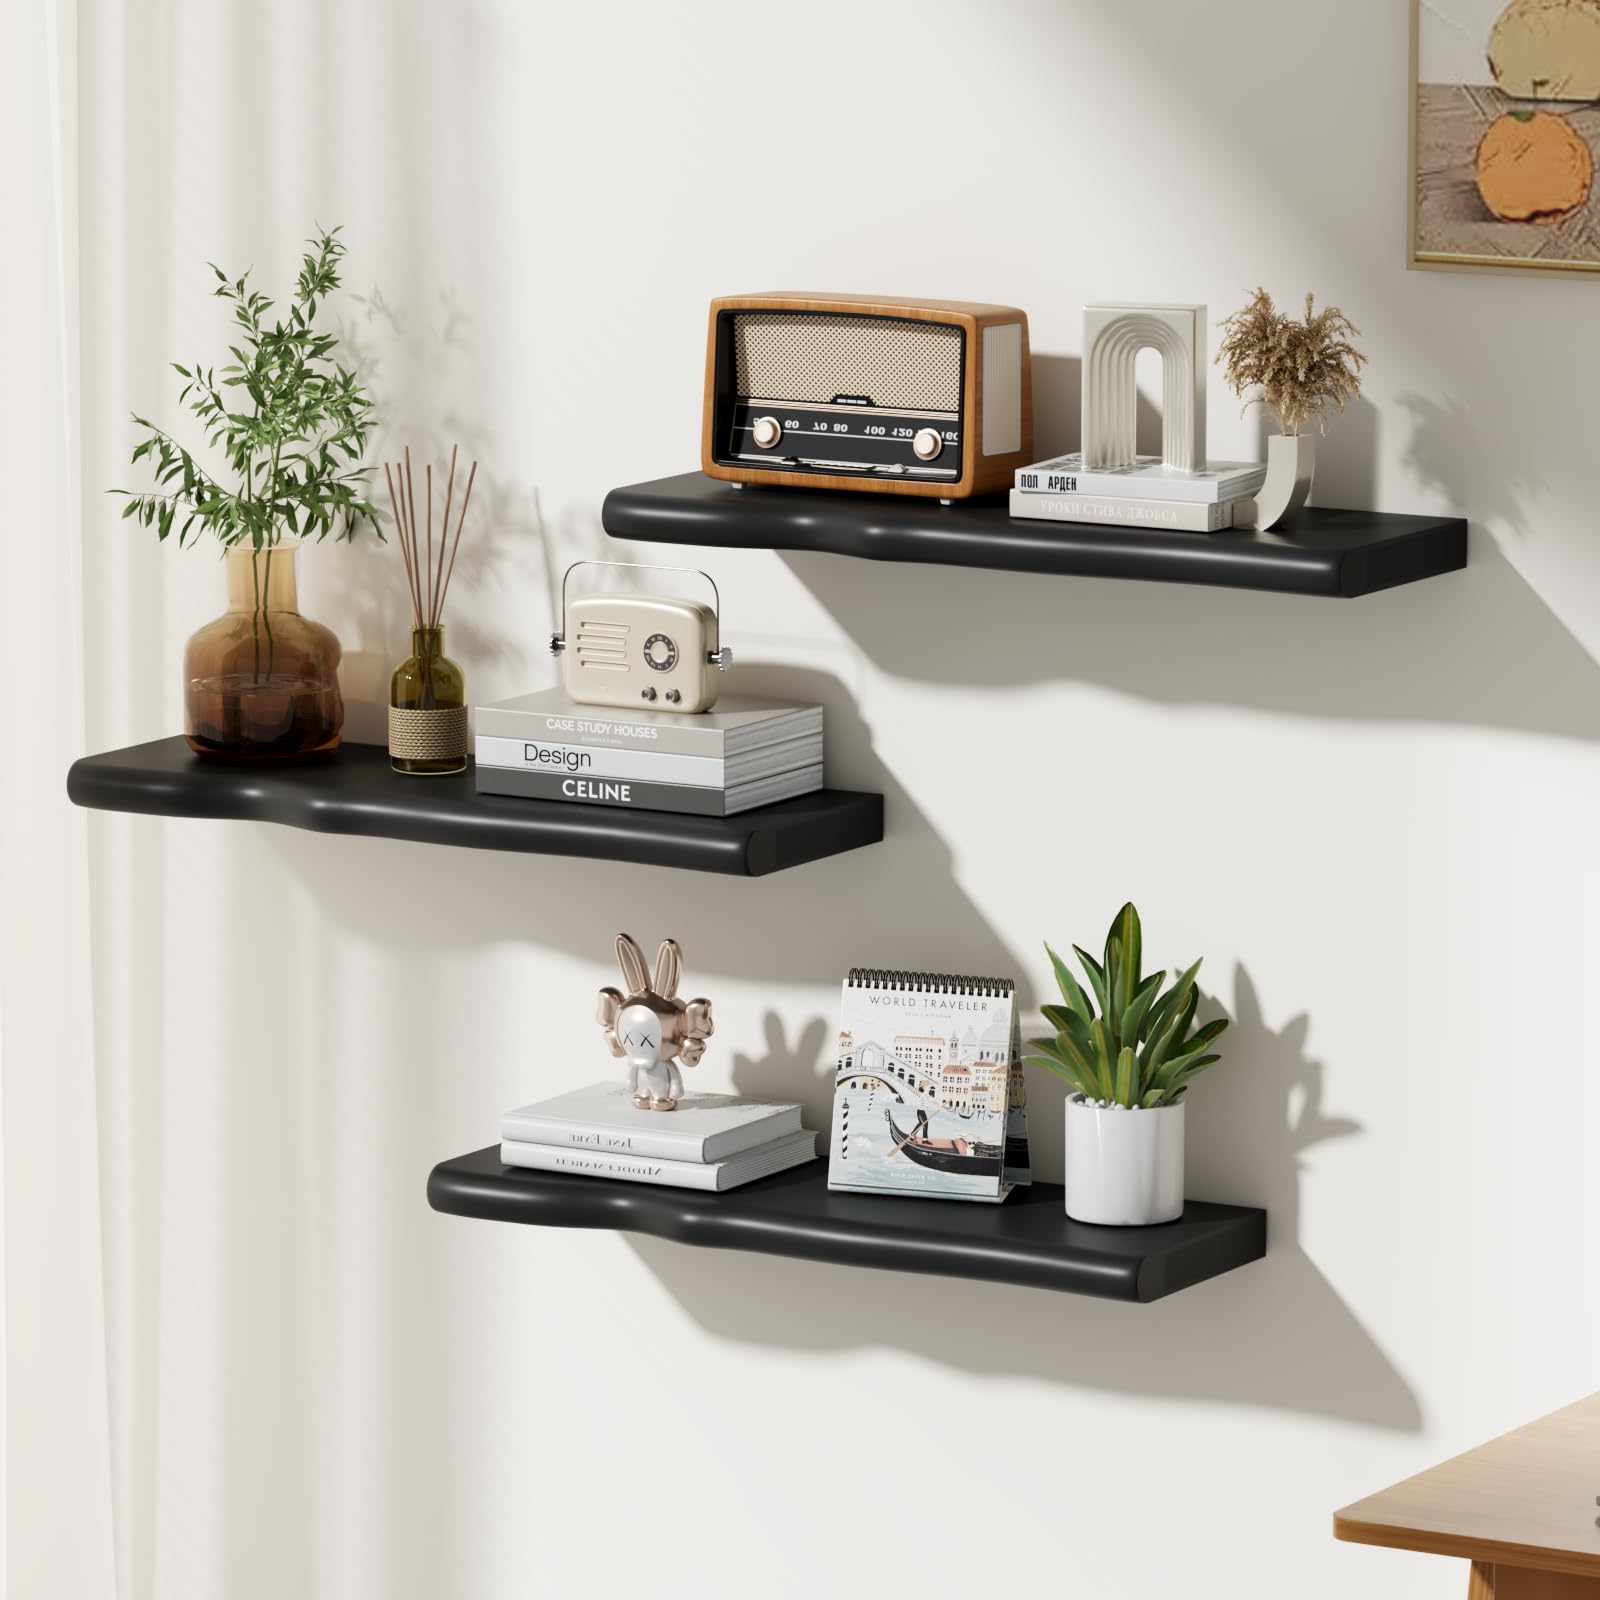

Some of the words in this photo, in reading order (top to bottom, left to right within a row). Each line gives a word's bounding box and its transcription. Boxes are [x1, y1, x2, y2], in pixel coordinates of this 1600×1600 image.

[1020, 474, 1039, 489] ПОЛ
[1047, 475, 1077, 492] АРДЕН
[1040, 499, 1080, 515] УРОКИ
[1083, 503, 1122, 518] СТИВА
[1126, 506, 1178, 522] ДЖОБСА
[546, 718, 575, 732] CASE
[577, 721, 612, 735] STUDY
[614, 724, 658, 739] HOUSES
[524, 743, 592, 772] Design
[561, 779, 631, 802] CELINE
[869, 995, 916, 1007] WORLD
[923, 998, 988, 1012] TRAVELER
